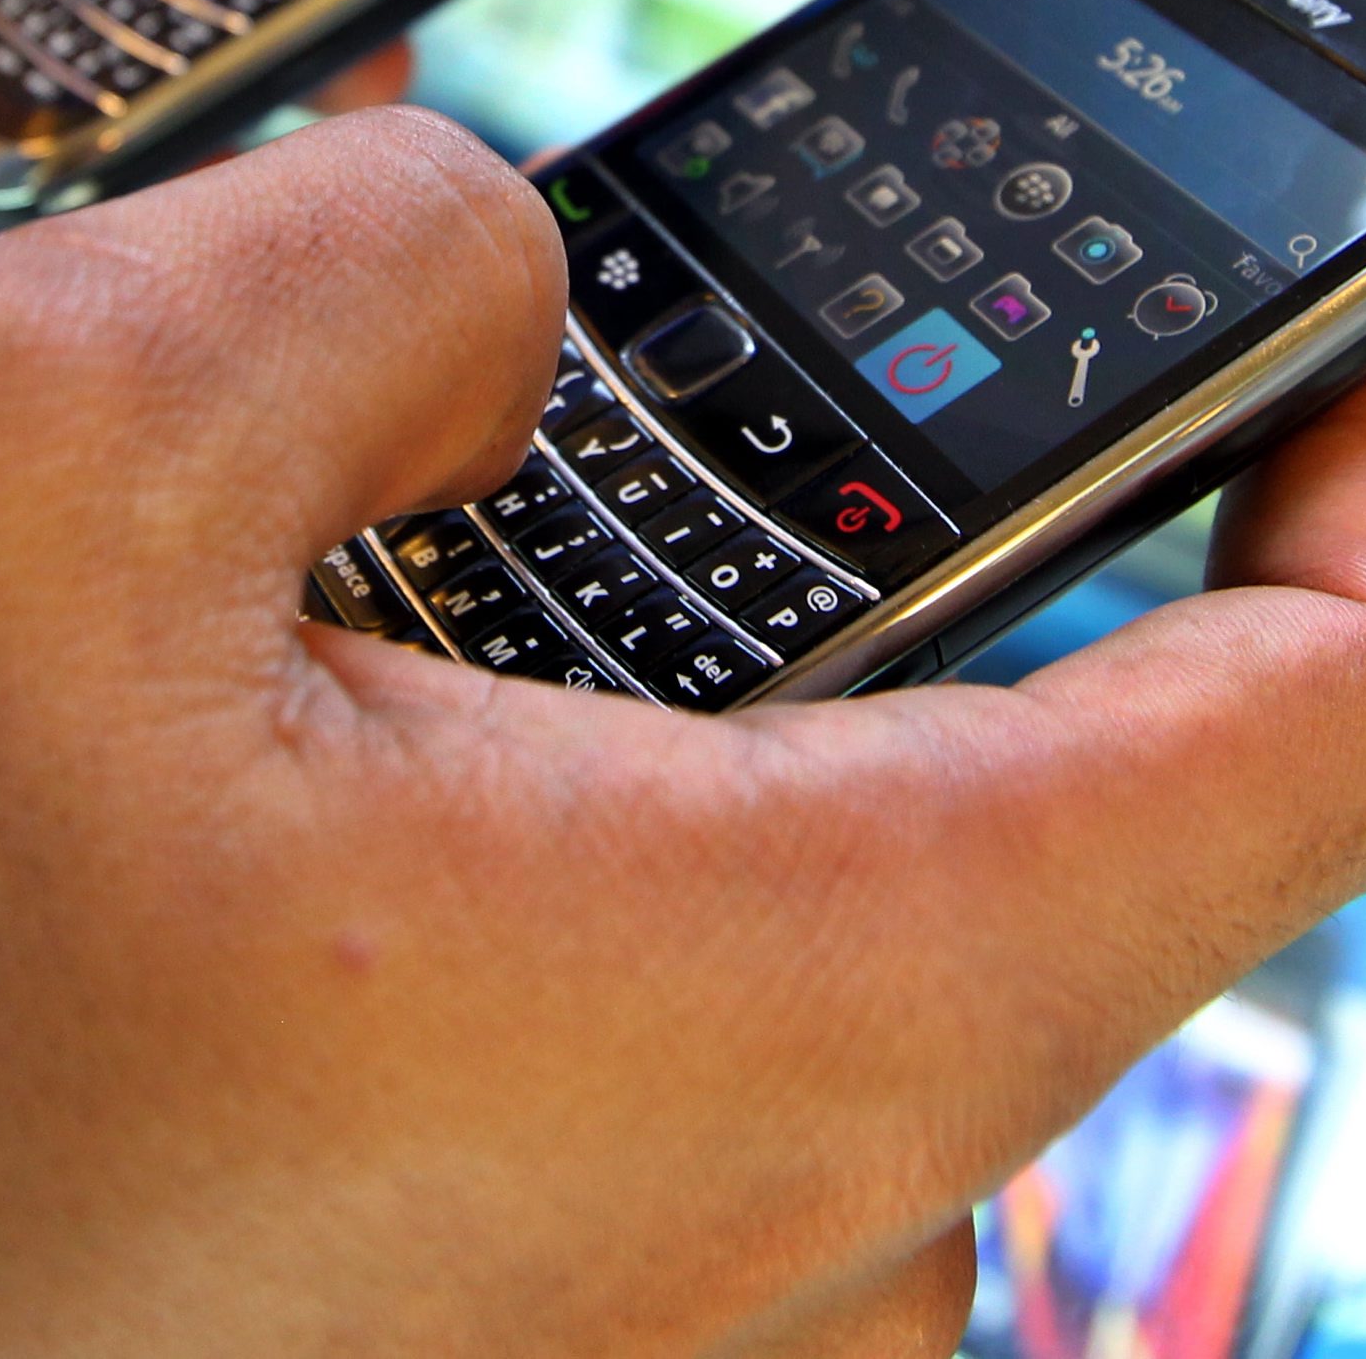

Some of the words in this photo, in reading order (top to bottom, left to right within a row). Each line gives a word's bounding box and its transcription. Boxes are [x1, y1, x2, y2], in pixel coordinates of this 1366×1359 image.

[1096, 37, 1186, 101] 5:26
[577, 438, 606, 459] Y
[495, 492, 526, 517] H
[618, 480, 649, 504] U
[664, 526, 691, 543] I
[411, 545, 438, 569] B
[535, 545, 564, 560] J
[711, 564, 740, 589] O
[445, 591, 477, 617] N
[575, 581, 609, 607] K
[766, 607, 799, 628] P
[482, 635, 518, 666] M
[620, 625, 647, 651] L
[693, 654, 733, 685] del
